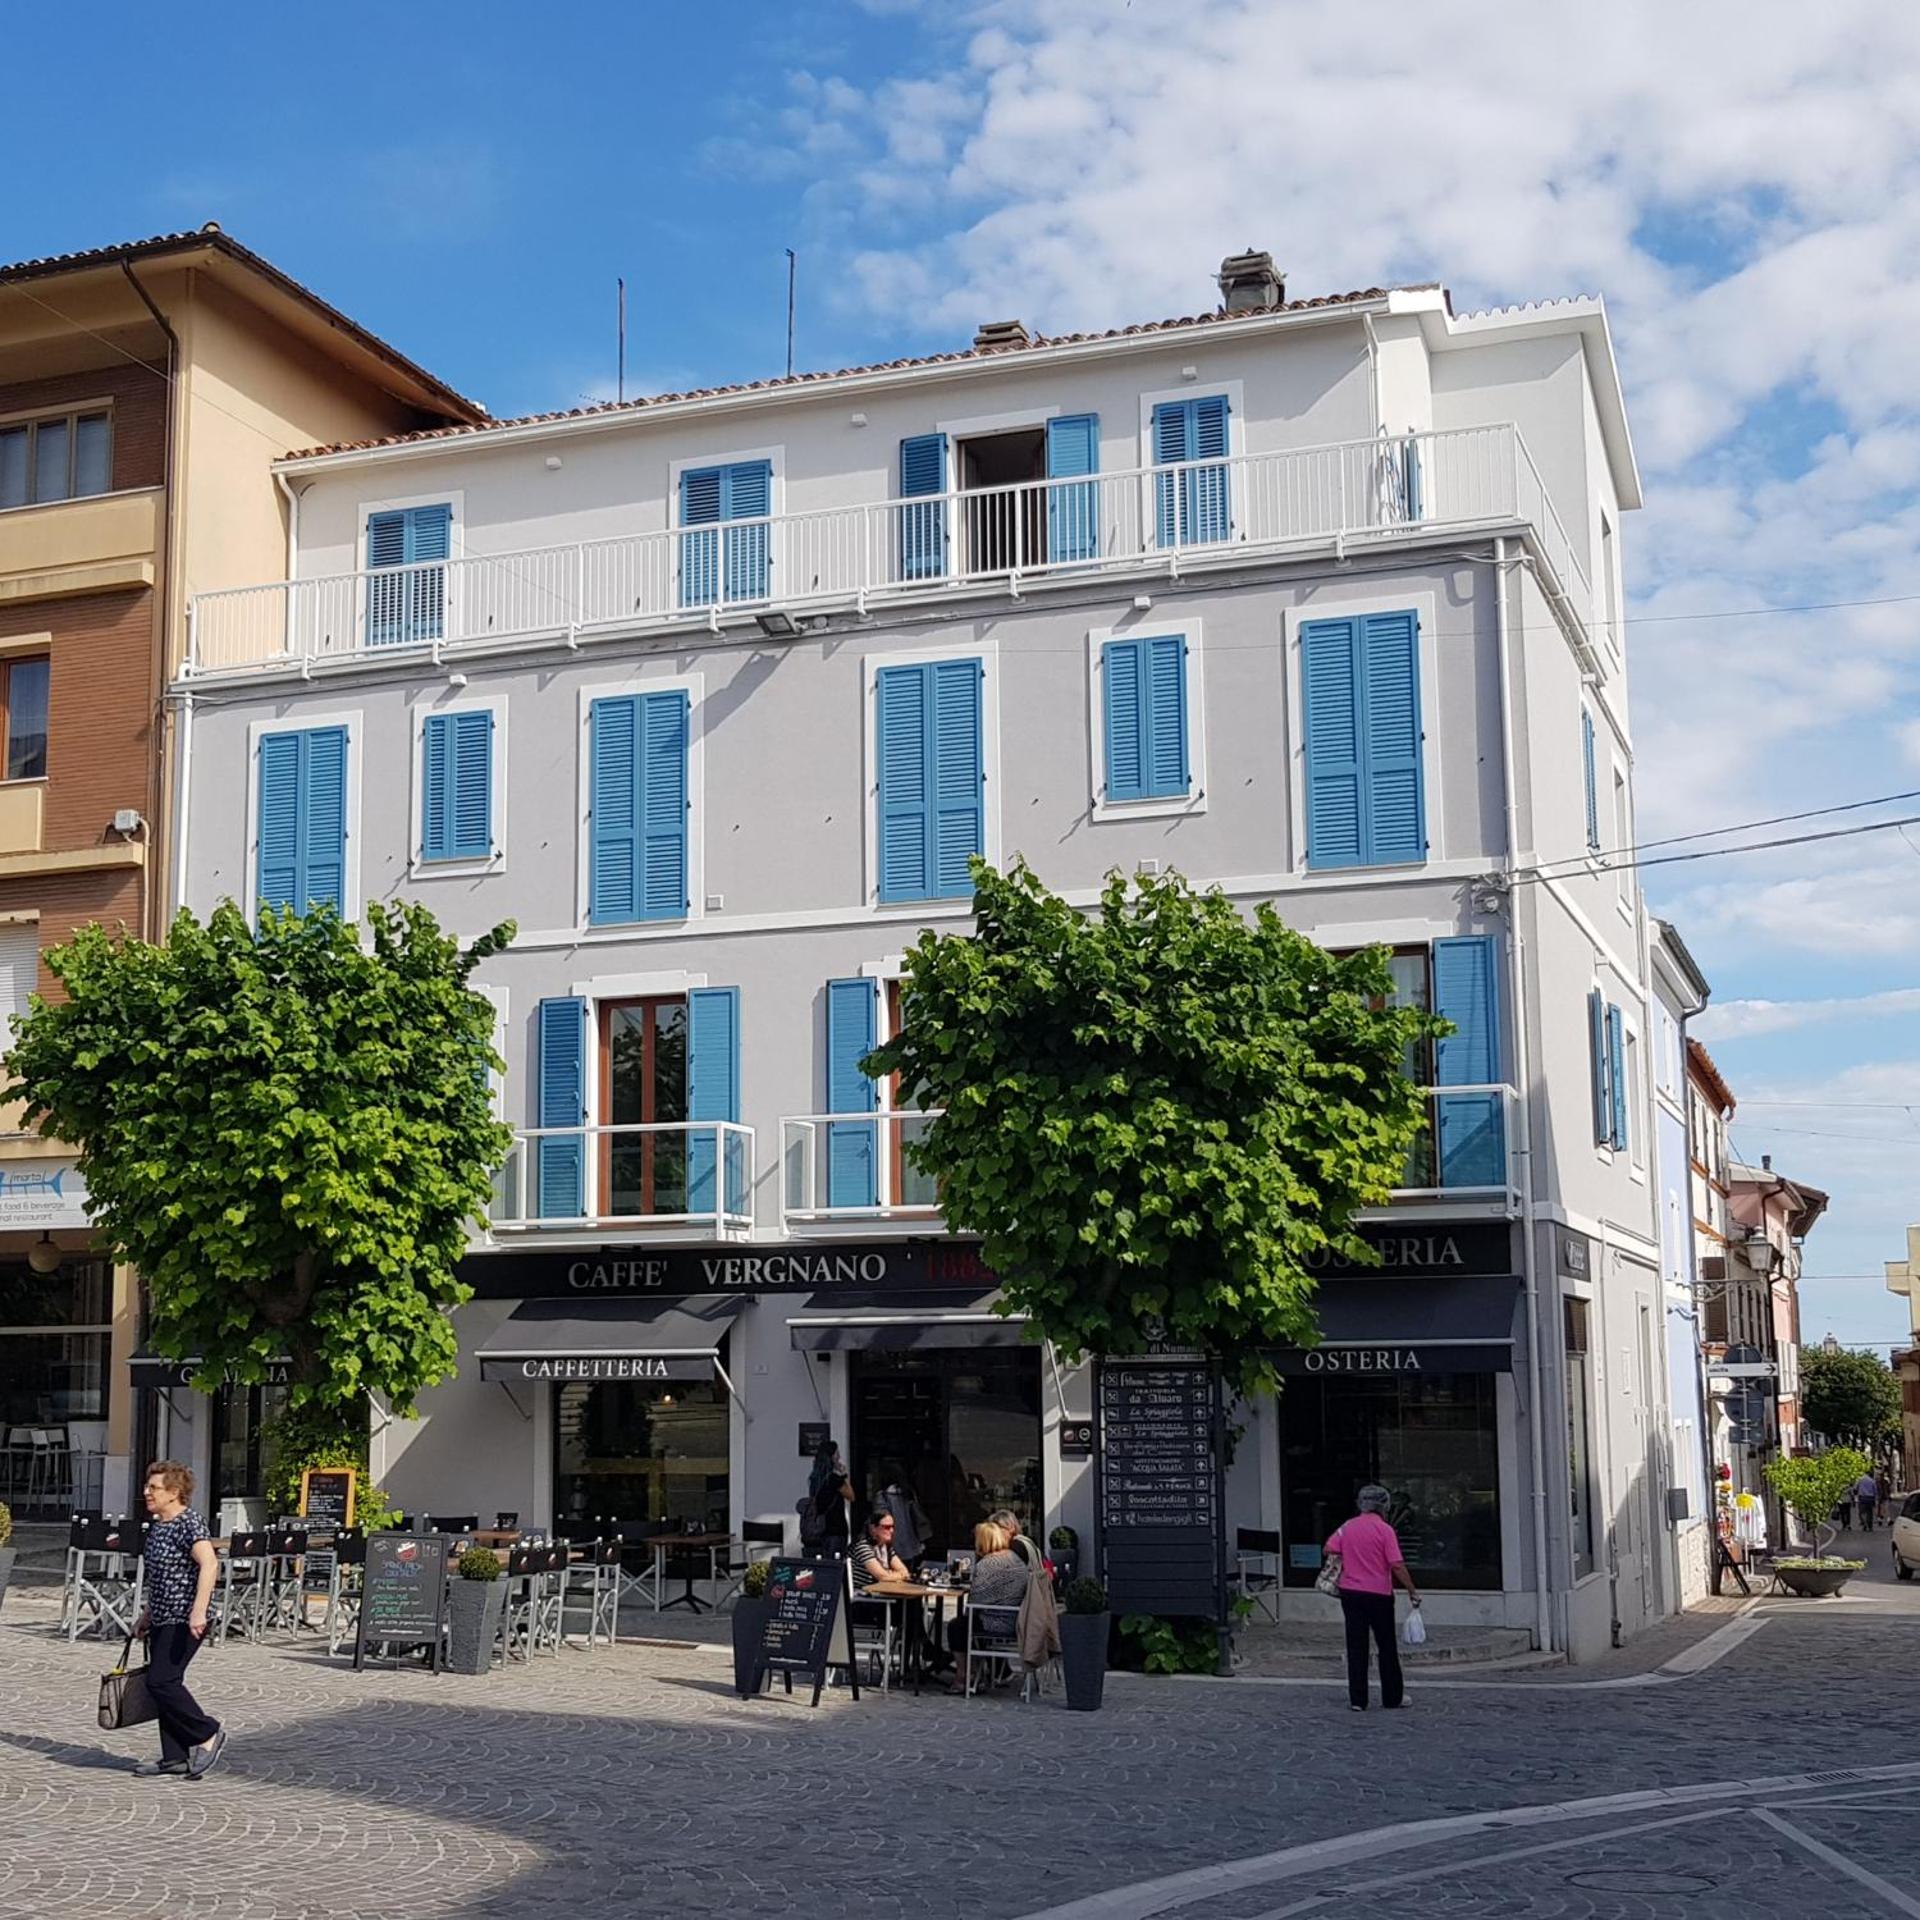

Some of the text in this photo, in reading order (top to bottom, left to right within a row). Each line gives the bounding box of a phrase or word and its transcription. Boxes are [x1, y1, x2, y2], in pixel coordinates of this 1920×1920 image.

[568, 1259, 668, 1288] CAFFE'
[700, 1254, 887, 1285] VERGNANO
[522, 1359, 668, 1377] CAFFETTERIA
[1305, 1350, 1422, 1371] OSTERIA
